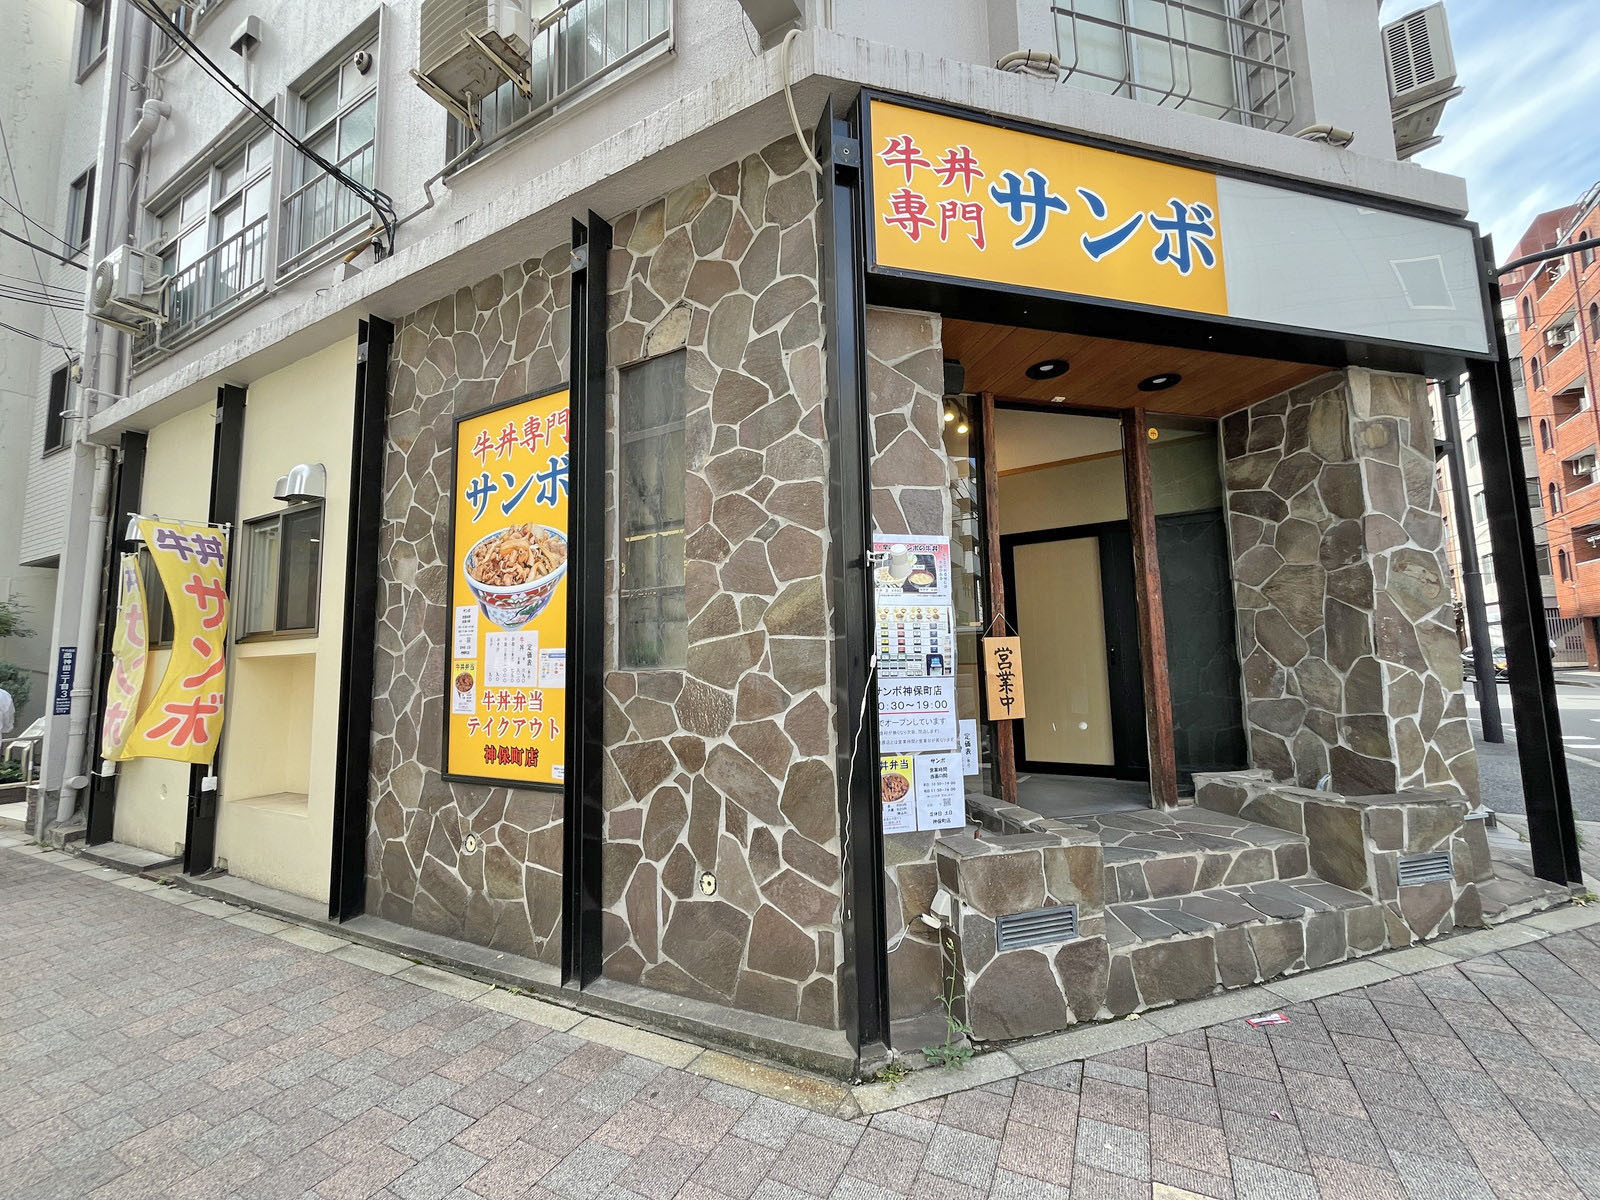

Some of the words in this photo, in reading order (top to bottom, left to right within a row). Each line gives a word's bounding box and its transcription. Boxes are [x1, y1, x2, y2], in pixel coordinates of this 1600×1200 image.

[879, 134, 985, 194] 牛丼
[882, 188, 986, 251] 専門
[989, 169, 1217, 277] サンボ
[472, 408, 569, 465] 牛丼専門
[465, 452, 569, 522] サンボ
[155, 528, 226, 568] 牛丼
[145, 575, 227, 748] サンボ
[993, 646, 1016, 716] 営業中
[467, 717, 560, 740] テイクアウト
[482, 690, 543, 711] 牛丼弁当
[483, 744, 540, 768] 神保町店
